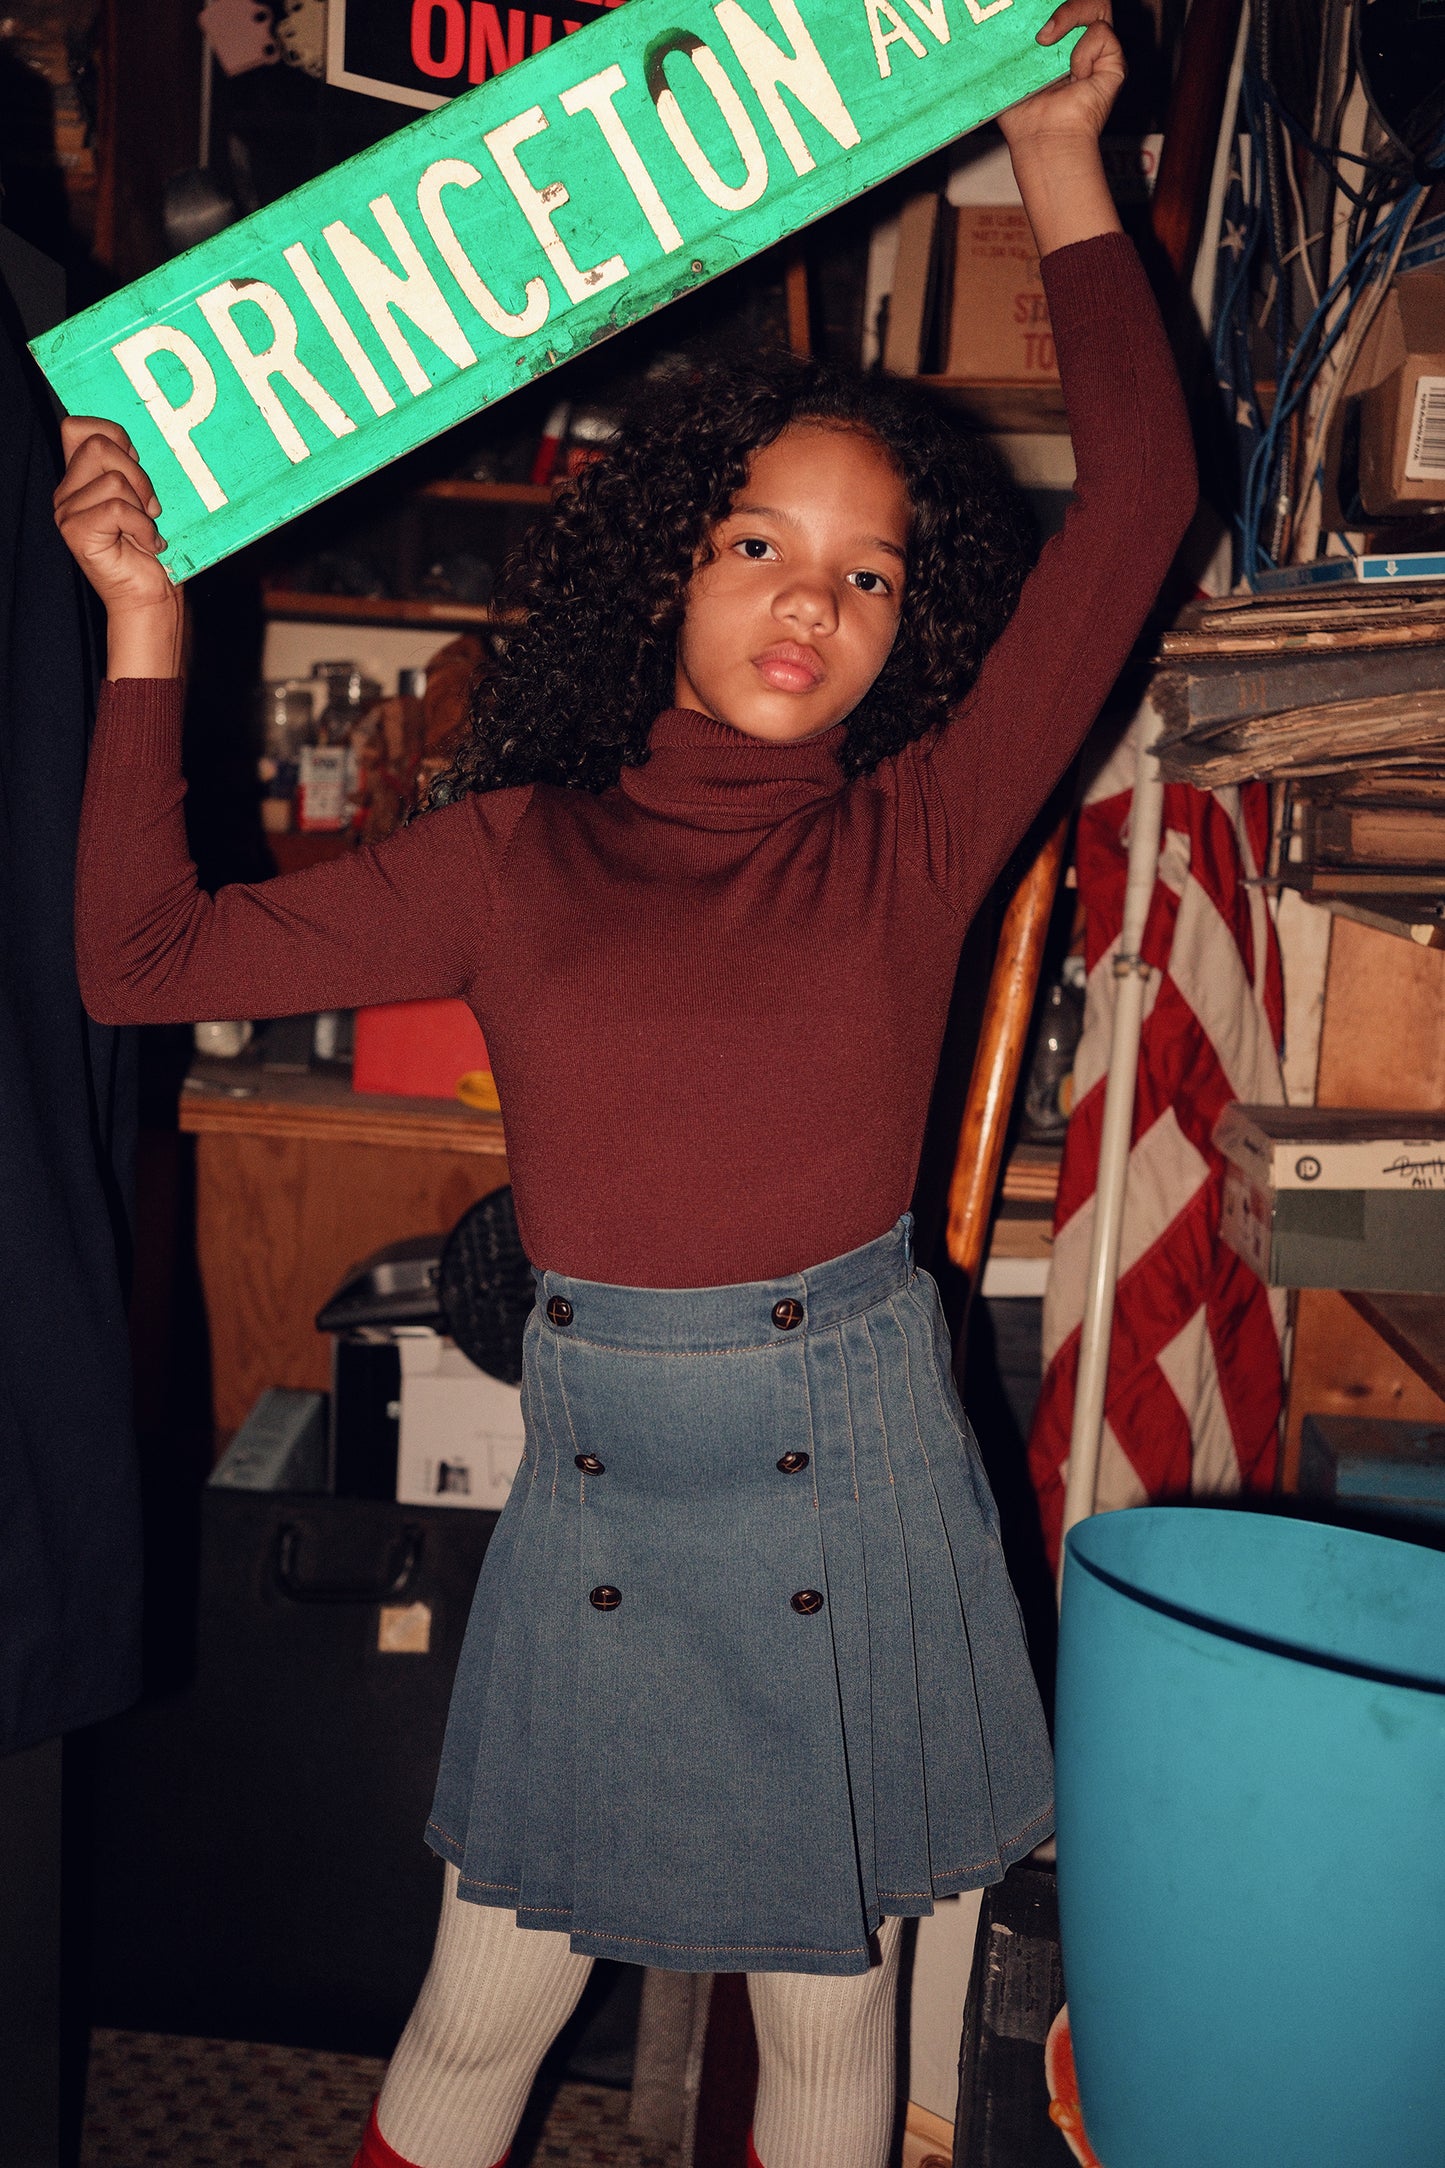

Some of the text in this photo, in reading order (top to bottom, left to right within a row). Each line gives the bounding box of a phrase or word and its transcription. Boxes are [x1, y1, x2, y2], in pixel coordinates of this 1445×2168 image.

[410, 0, 583, 85] ON
[112, 0, 1014, 512] PRINCETON AV
